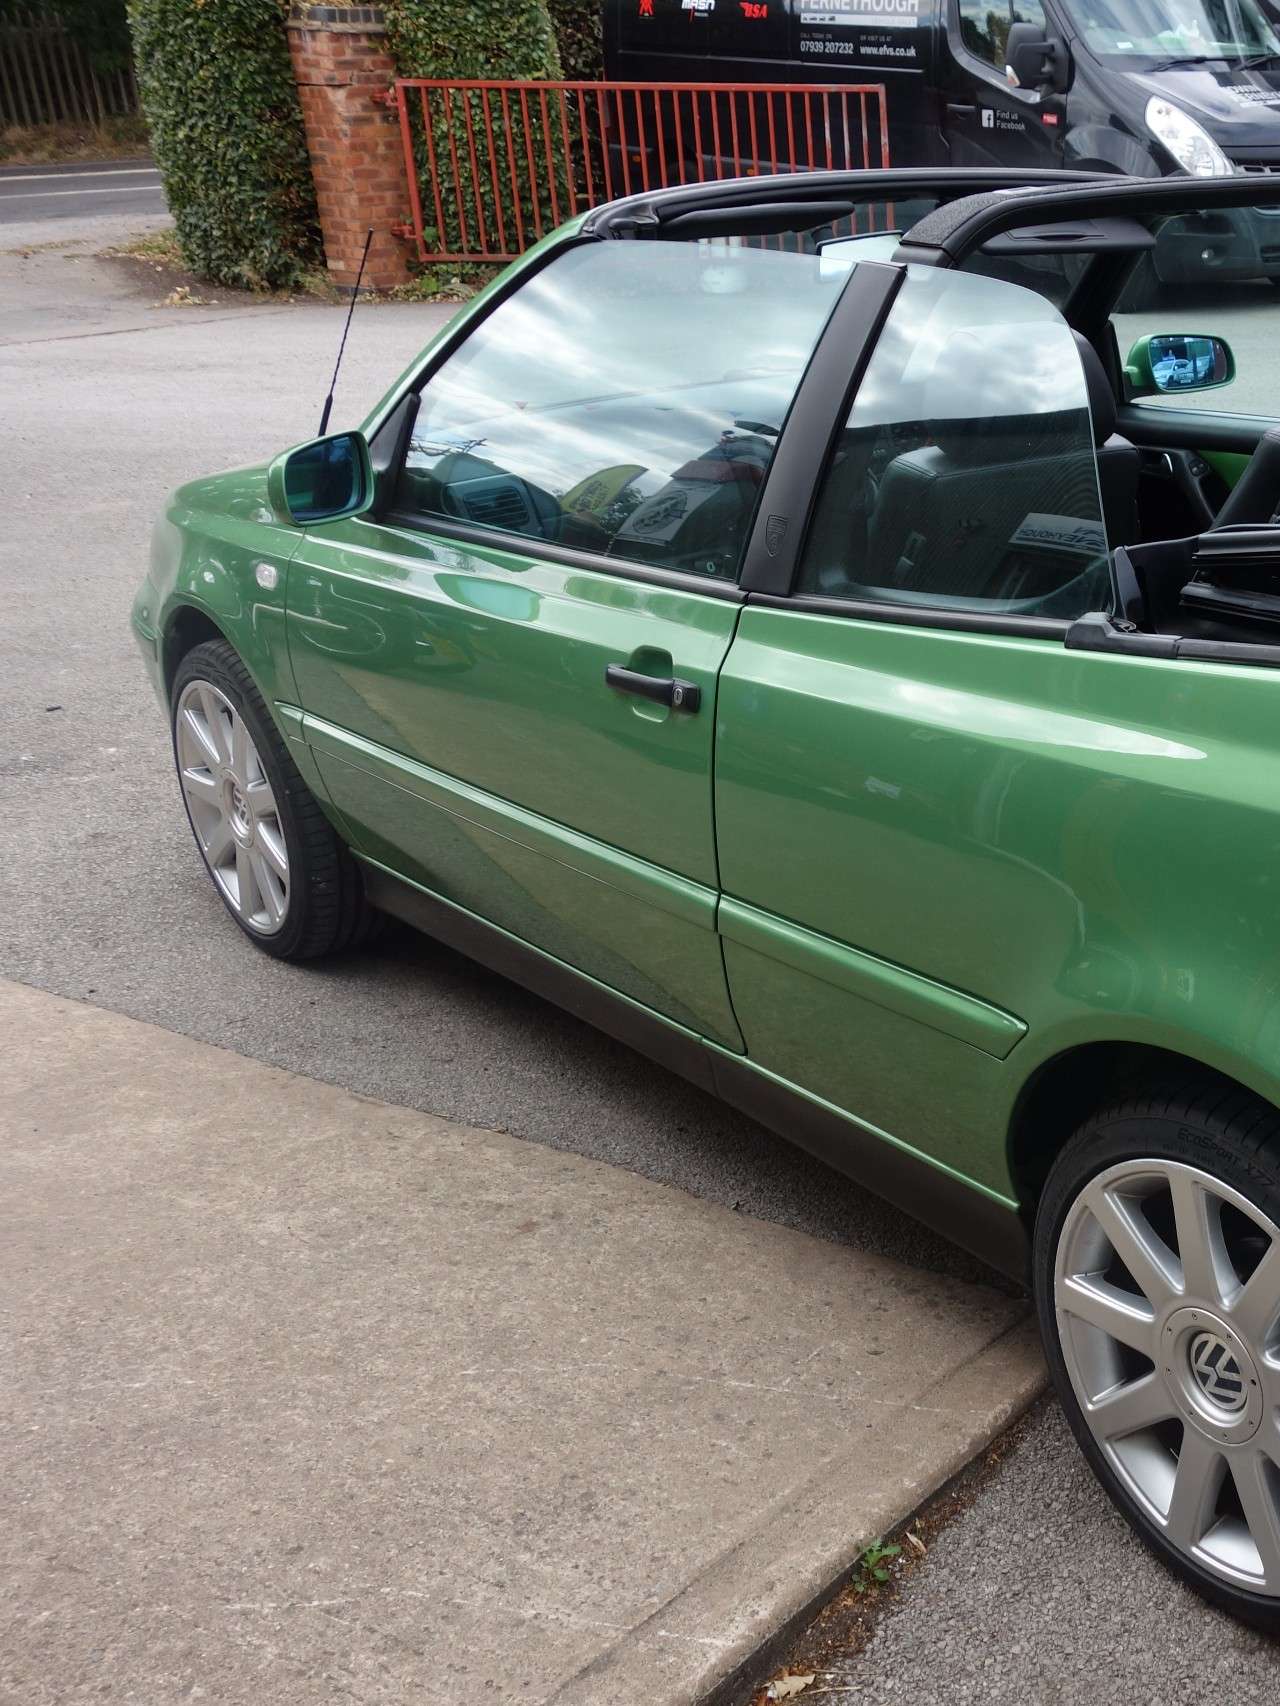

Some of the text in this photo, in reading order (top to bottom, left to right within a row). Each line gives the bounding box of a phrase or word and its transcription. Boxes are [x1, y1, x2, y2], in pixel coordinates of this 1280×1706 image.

[800, 41, 854, 54] 07939 207232
[860, 45, 917, 57] www.efvs.co.uk
[996, 109, 1019, 120] Find us
[996, 120, 1026, 130] Facebook
